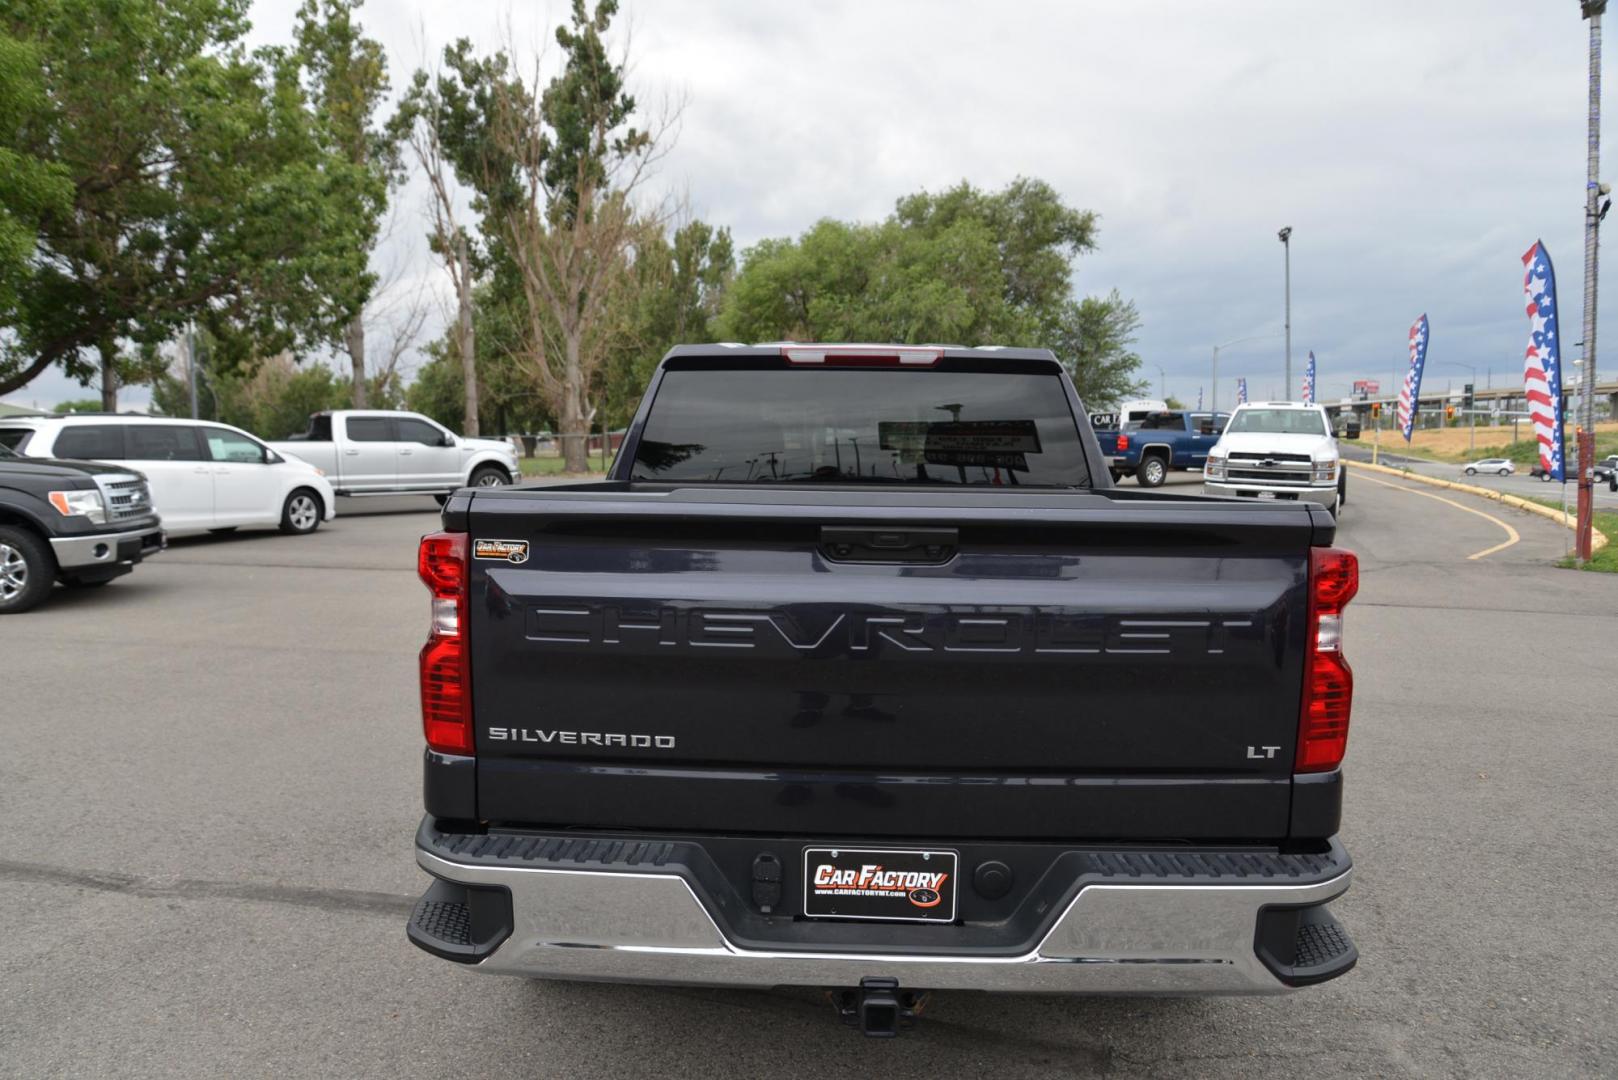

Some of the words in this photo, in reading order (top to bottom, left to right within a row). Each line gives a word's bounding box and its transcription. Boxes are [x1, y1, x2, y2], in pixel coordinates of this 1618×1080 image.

[524, 605, 1253, 655] CHEVROLET
[488, 727, 676, 748] SILVERADO
[1247, 746, 1281, 759] LT
[814, 864, 857, 887] CAR
[858, 864, 946, 889] FACTORY
